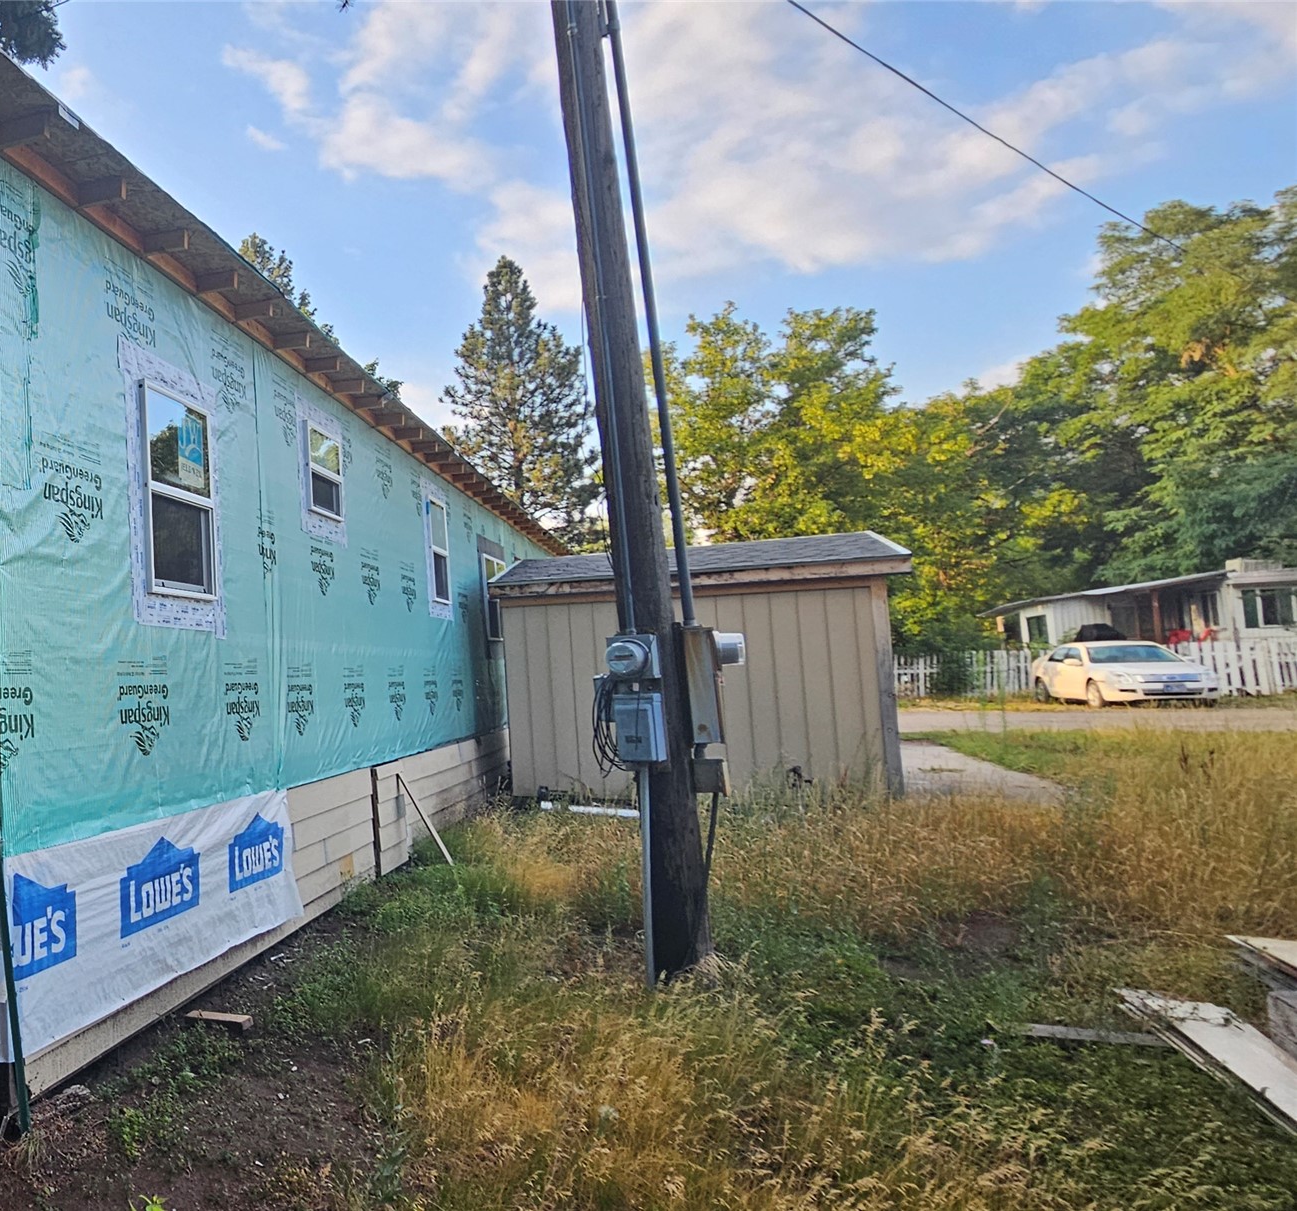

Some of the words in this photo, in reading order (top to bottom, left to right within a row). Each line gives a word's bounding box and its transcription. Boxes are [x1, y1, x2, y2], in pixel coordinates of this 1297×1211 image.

[106, 302, 157, 348] Kingspan
[41, 458, 103, 491] GreenGuard
[42, 482, 104, 520] Kingspan
[118, 684, 169, 701] GreenGuard
[119, 701, 170, 727] Kingspan
[233, 835, 279, 882] LOWE'S
[129, 863, 193, 923] LOWE'S
[13, 905, 67, 968] WE'S
